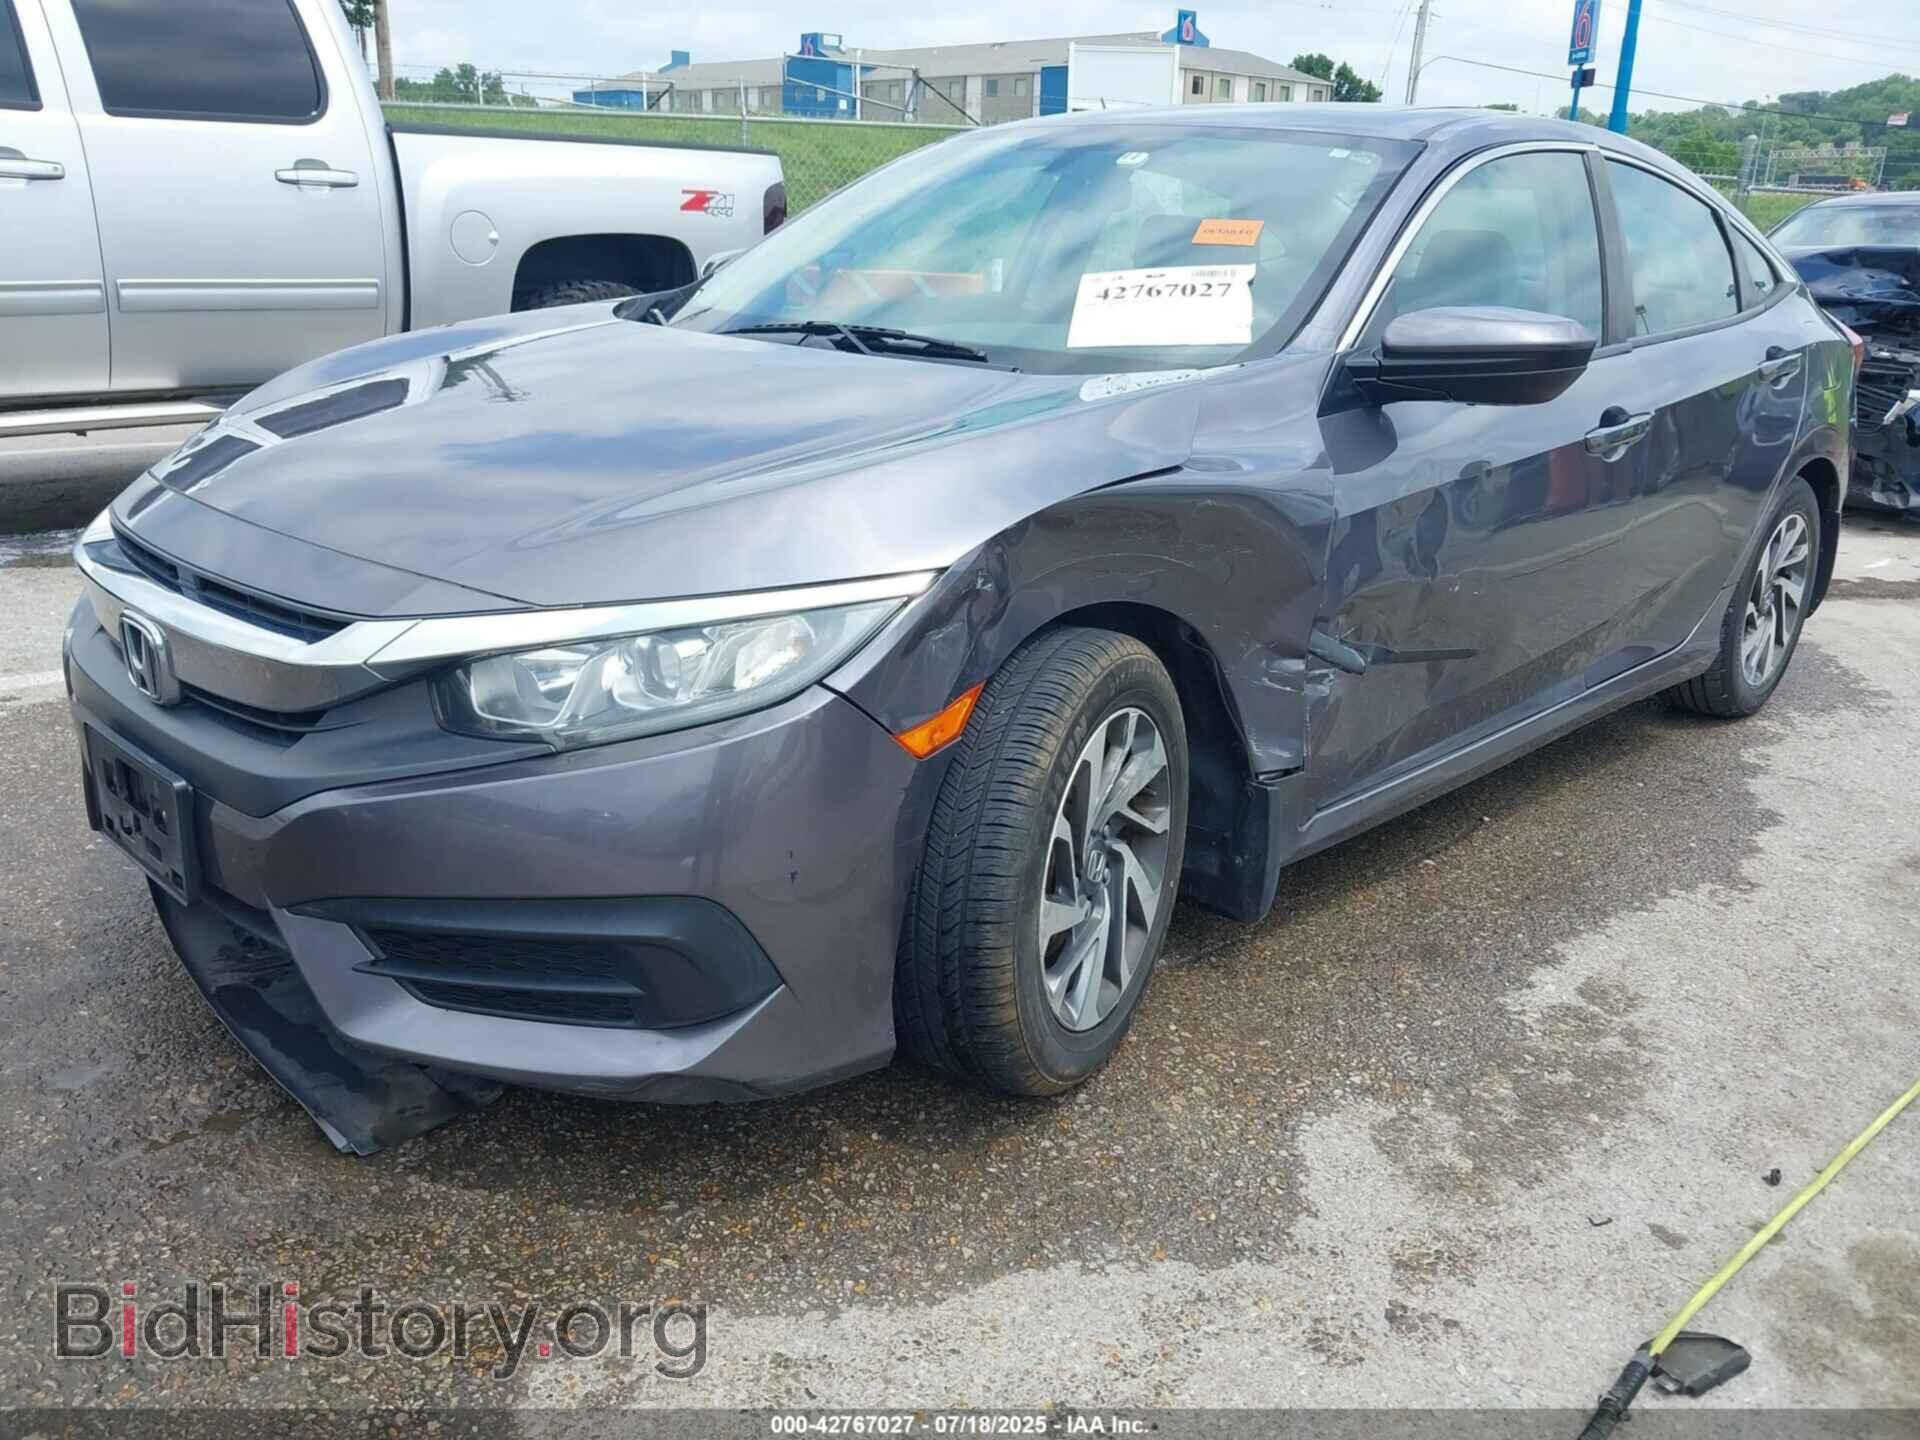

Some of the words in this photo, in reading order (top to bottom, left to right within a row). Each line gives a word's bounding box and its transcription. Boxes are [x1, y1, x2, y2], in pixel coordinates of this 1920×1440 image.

[1183, 15, 1193, 41] 6
[1575, 0, 1591, 48] 6
[1096, 282, 1232, 301] 42767027
